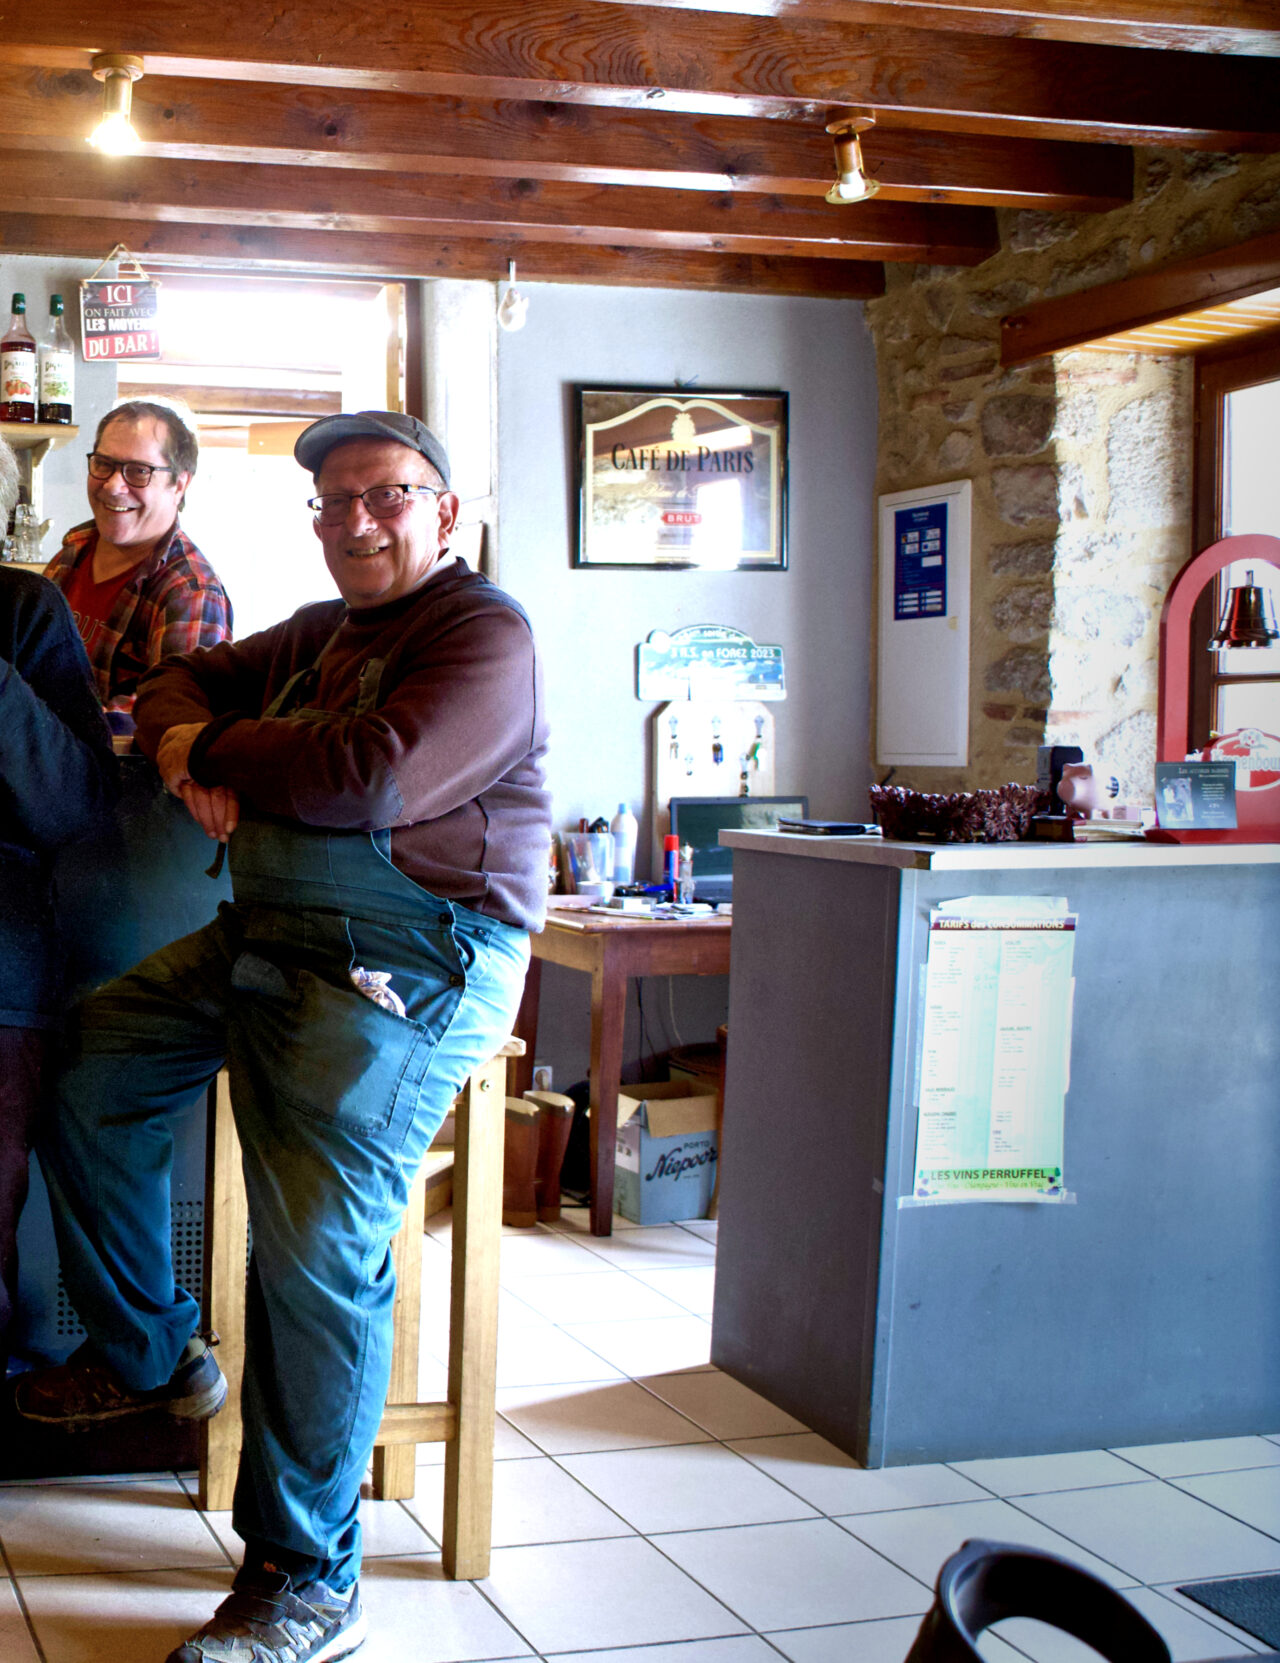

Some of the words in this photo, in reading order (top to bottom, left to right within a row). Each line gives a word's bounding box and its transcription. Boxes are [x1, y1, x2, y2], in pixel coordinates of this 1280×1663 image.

[106, 285, 132, 303] ICI
[85, 308, 101, 317] ON
[104, 308, 125, 317] FAIT
[128, 308, 154, 317] AVEC
[86, 318, 106, 332] LES
[108, 318, 155, 331] MOYE
[88, 338, 109, 358] DU
[114, 334, 148, 354] BAR
[611, 443, 661, 471] CAFÉ
[665, 450, 691, 472] DE
[697, 445, 754, 473] PARIS
[667, 514, 700, 523] BRUT
[716, 648, 747, 659] FOREZ
[750, 648, 775, 659] 2023
[683, 1140, 710, 1149] PORTO
[931, 1170, 950, 1180] LES
[953, 1169, 980, 1180] VINS
[982, 1168, 1047, 1179] PERRUFFEL
